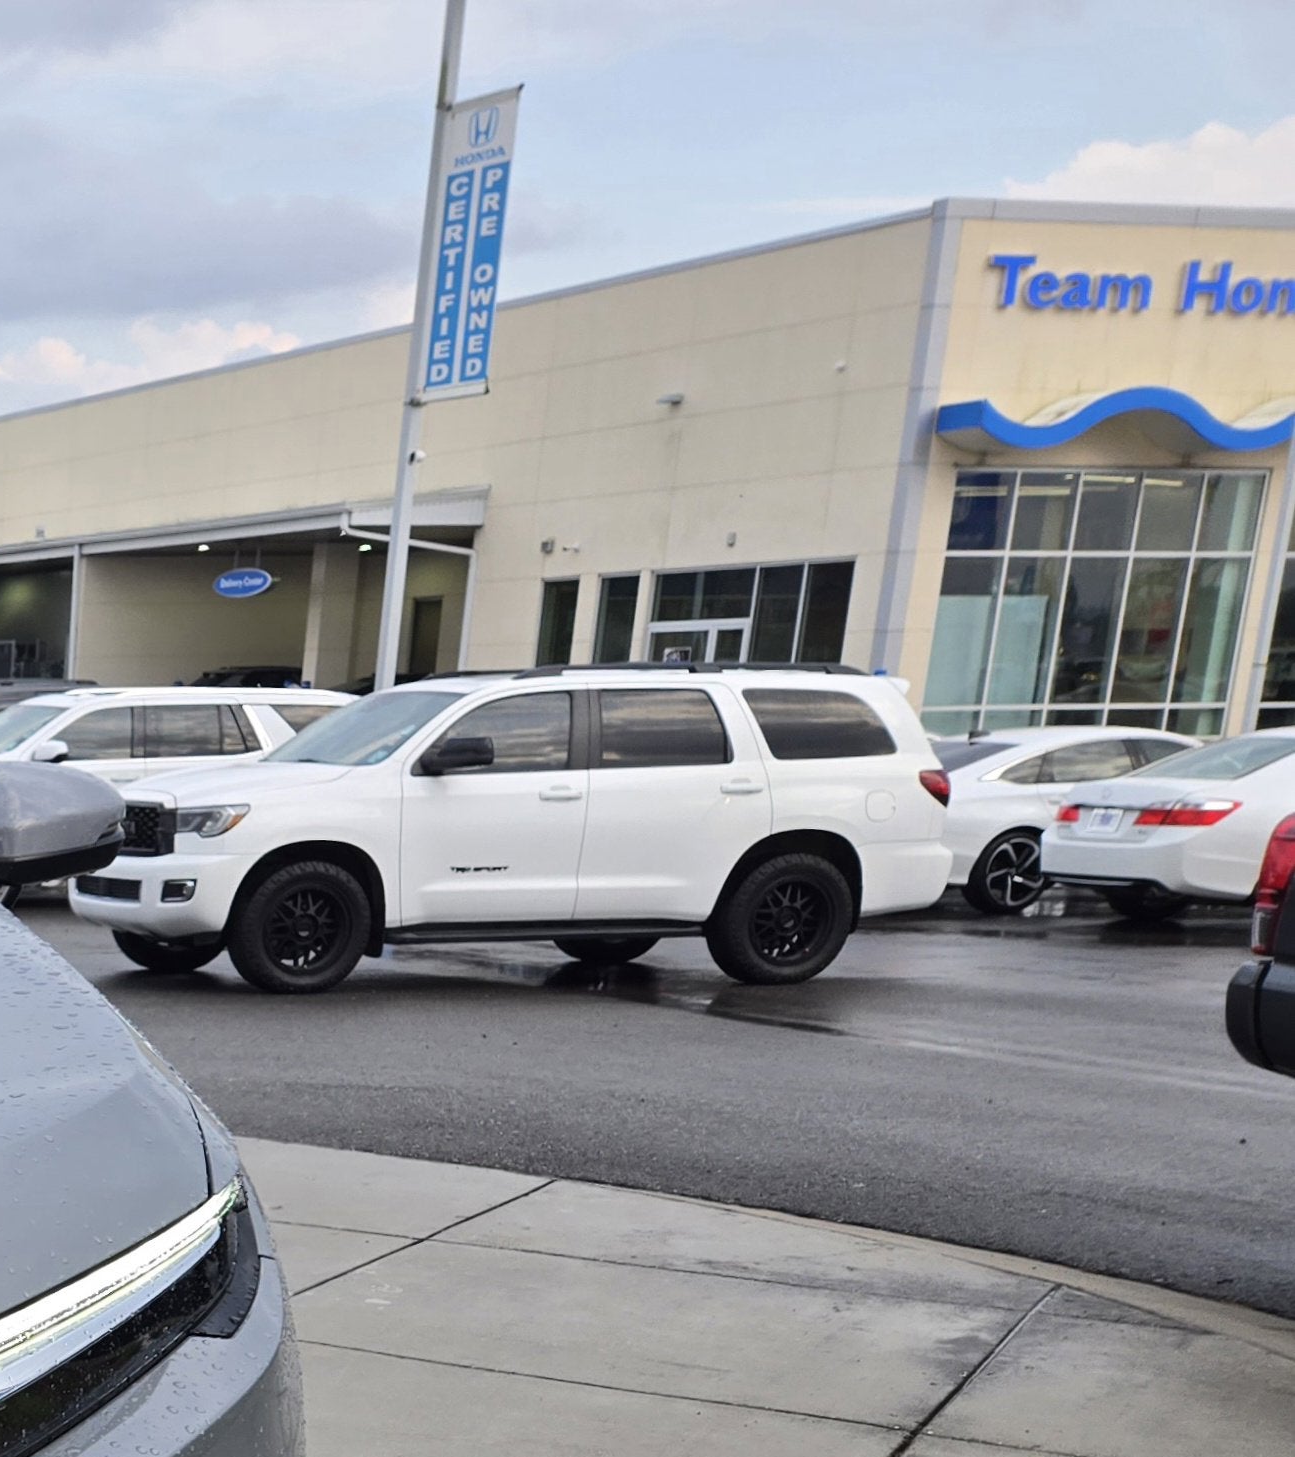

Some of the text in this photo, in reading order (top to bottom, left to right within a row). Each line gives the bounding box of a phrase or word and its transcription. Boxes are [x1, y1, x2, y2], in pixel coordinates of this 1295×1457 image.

[453, 144, 507, 168] HONDA
[429, 175, 470, 383] CERTIFIED
[464, 167, 504, 378] PRE OWNED
[989, 253, 1153, 311] Team
